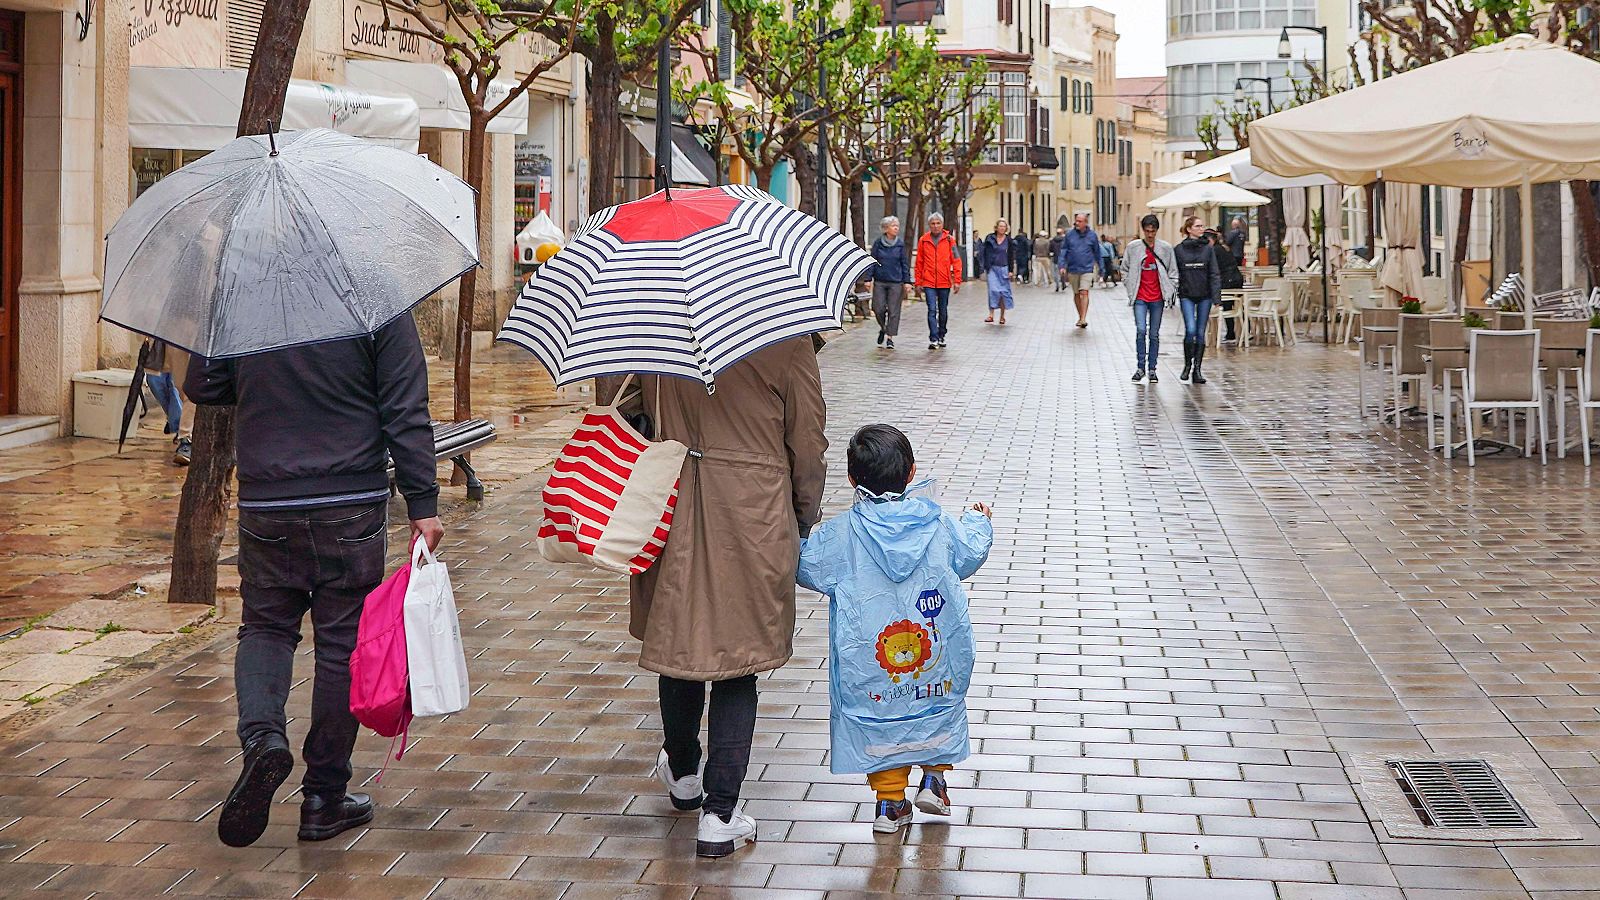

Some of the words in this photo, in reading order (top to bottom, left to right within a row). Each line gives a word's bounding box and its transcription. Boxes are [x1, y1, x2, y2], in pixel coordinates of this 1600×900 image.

[351, 5, 387, 48] Snack
[920, 595, 941, 612] BOY
[915, 679, 952, 700] LION
